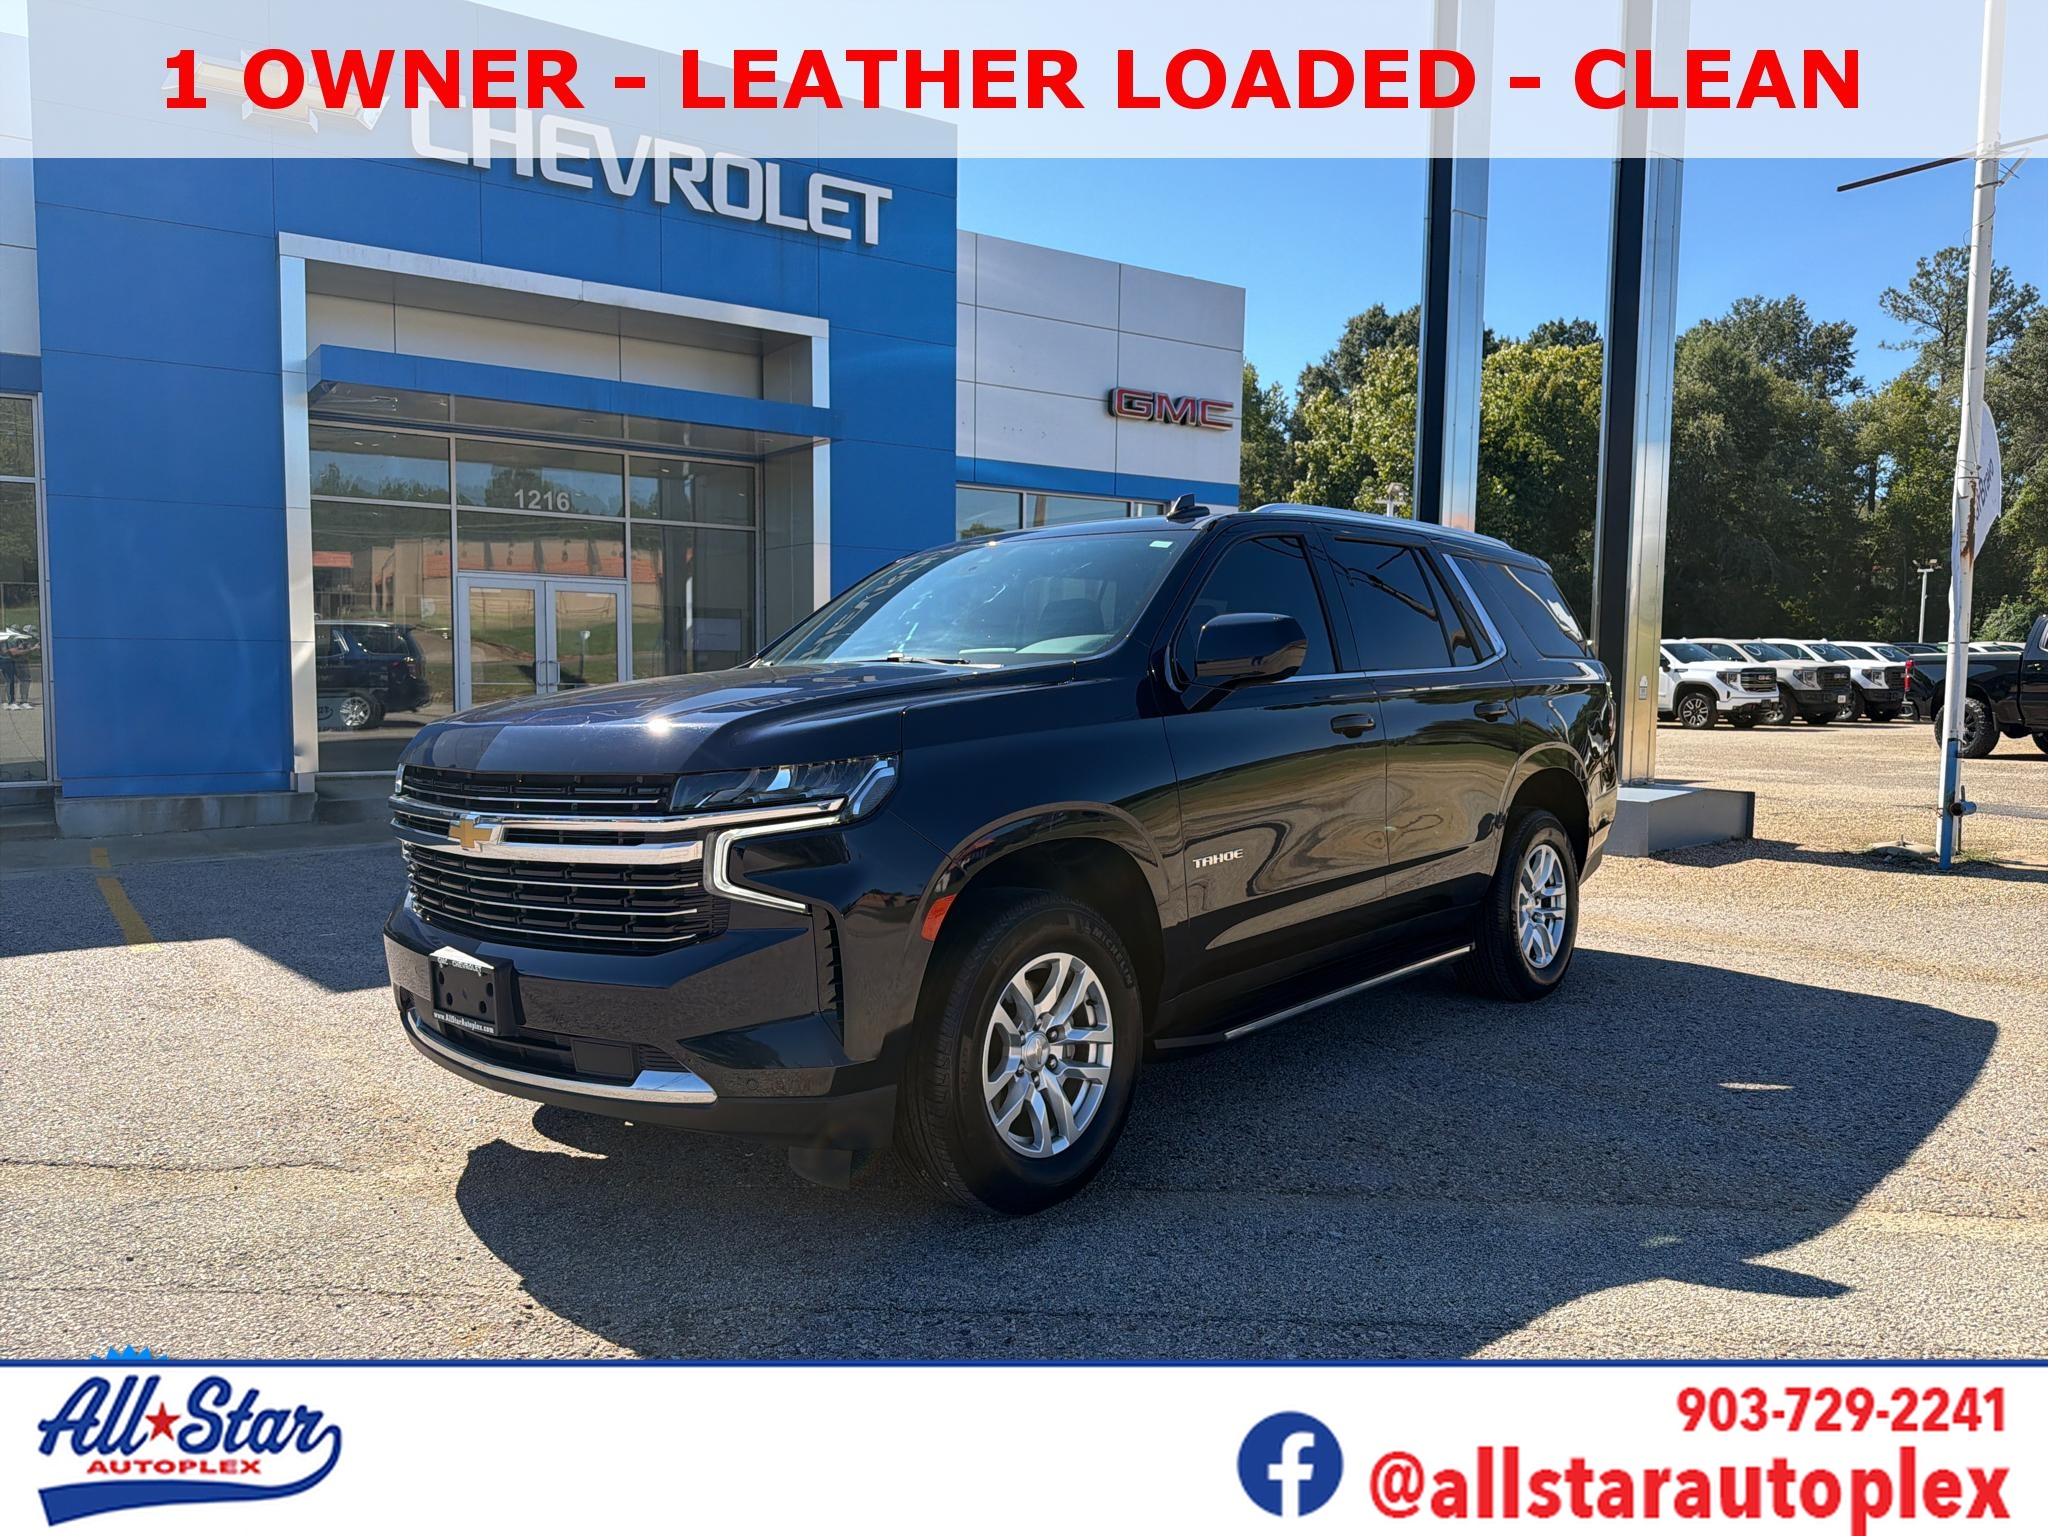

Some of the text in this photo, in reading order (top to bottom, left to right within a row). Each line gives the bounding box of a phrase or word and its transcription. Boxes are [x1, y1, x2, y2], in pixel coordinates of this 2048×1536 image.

[411, 87, 893, 246] CHEVROLET
[1109, 387, 1233, 431] GMC
[514, 488, 570, 512] 1216
[1192, 848, 1244, 869] TAHOE
